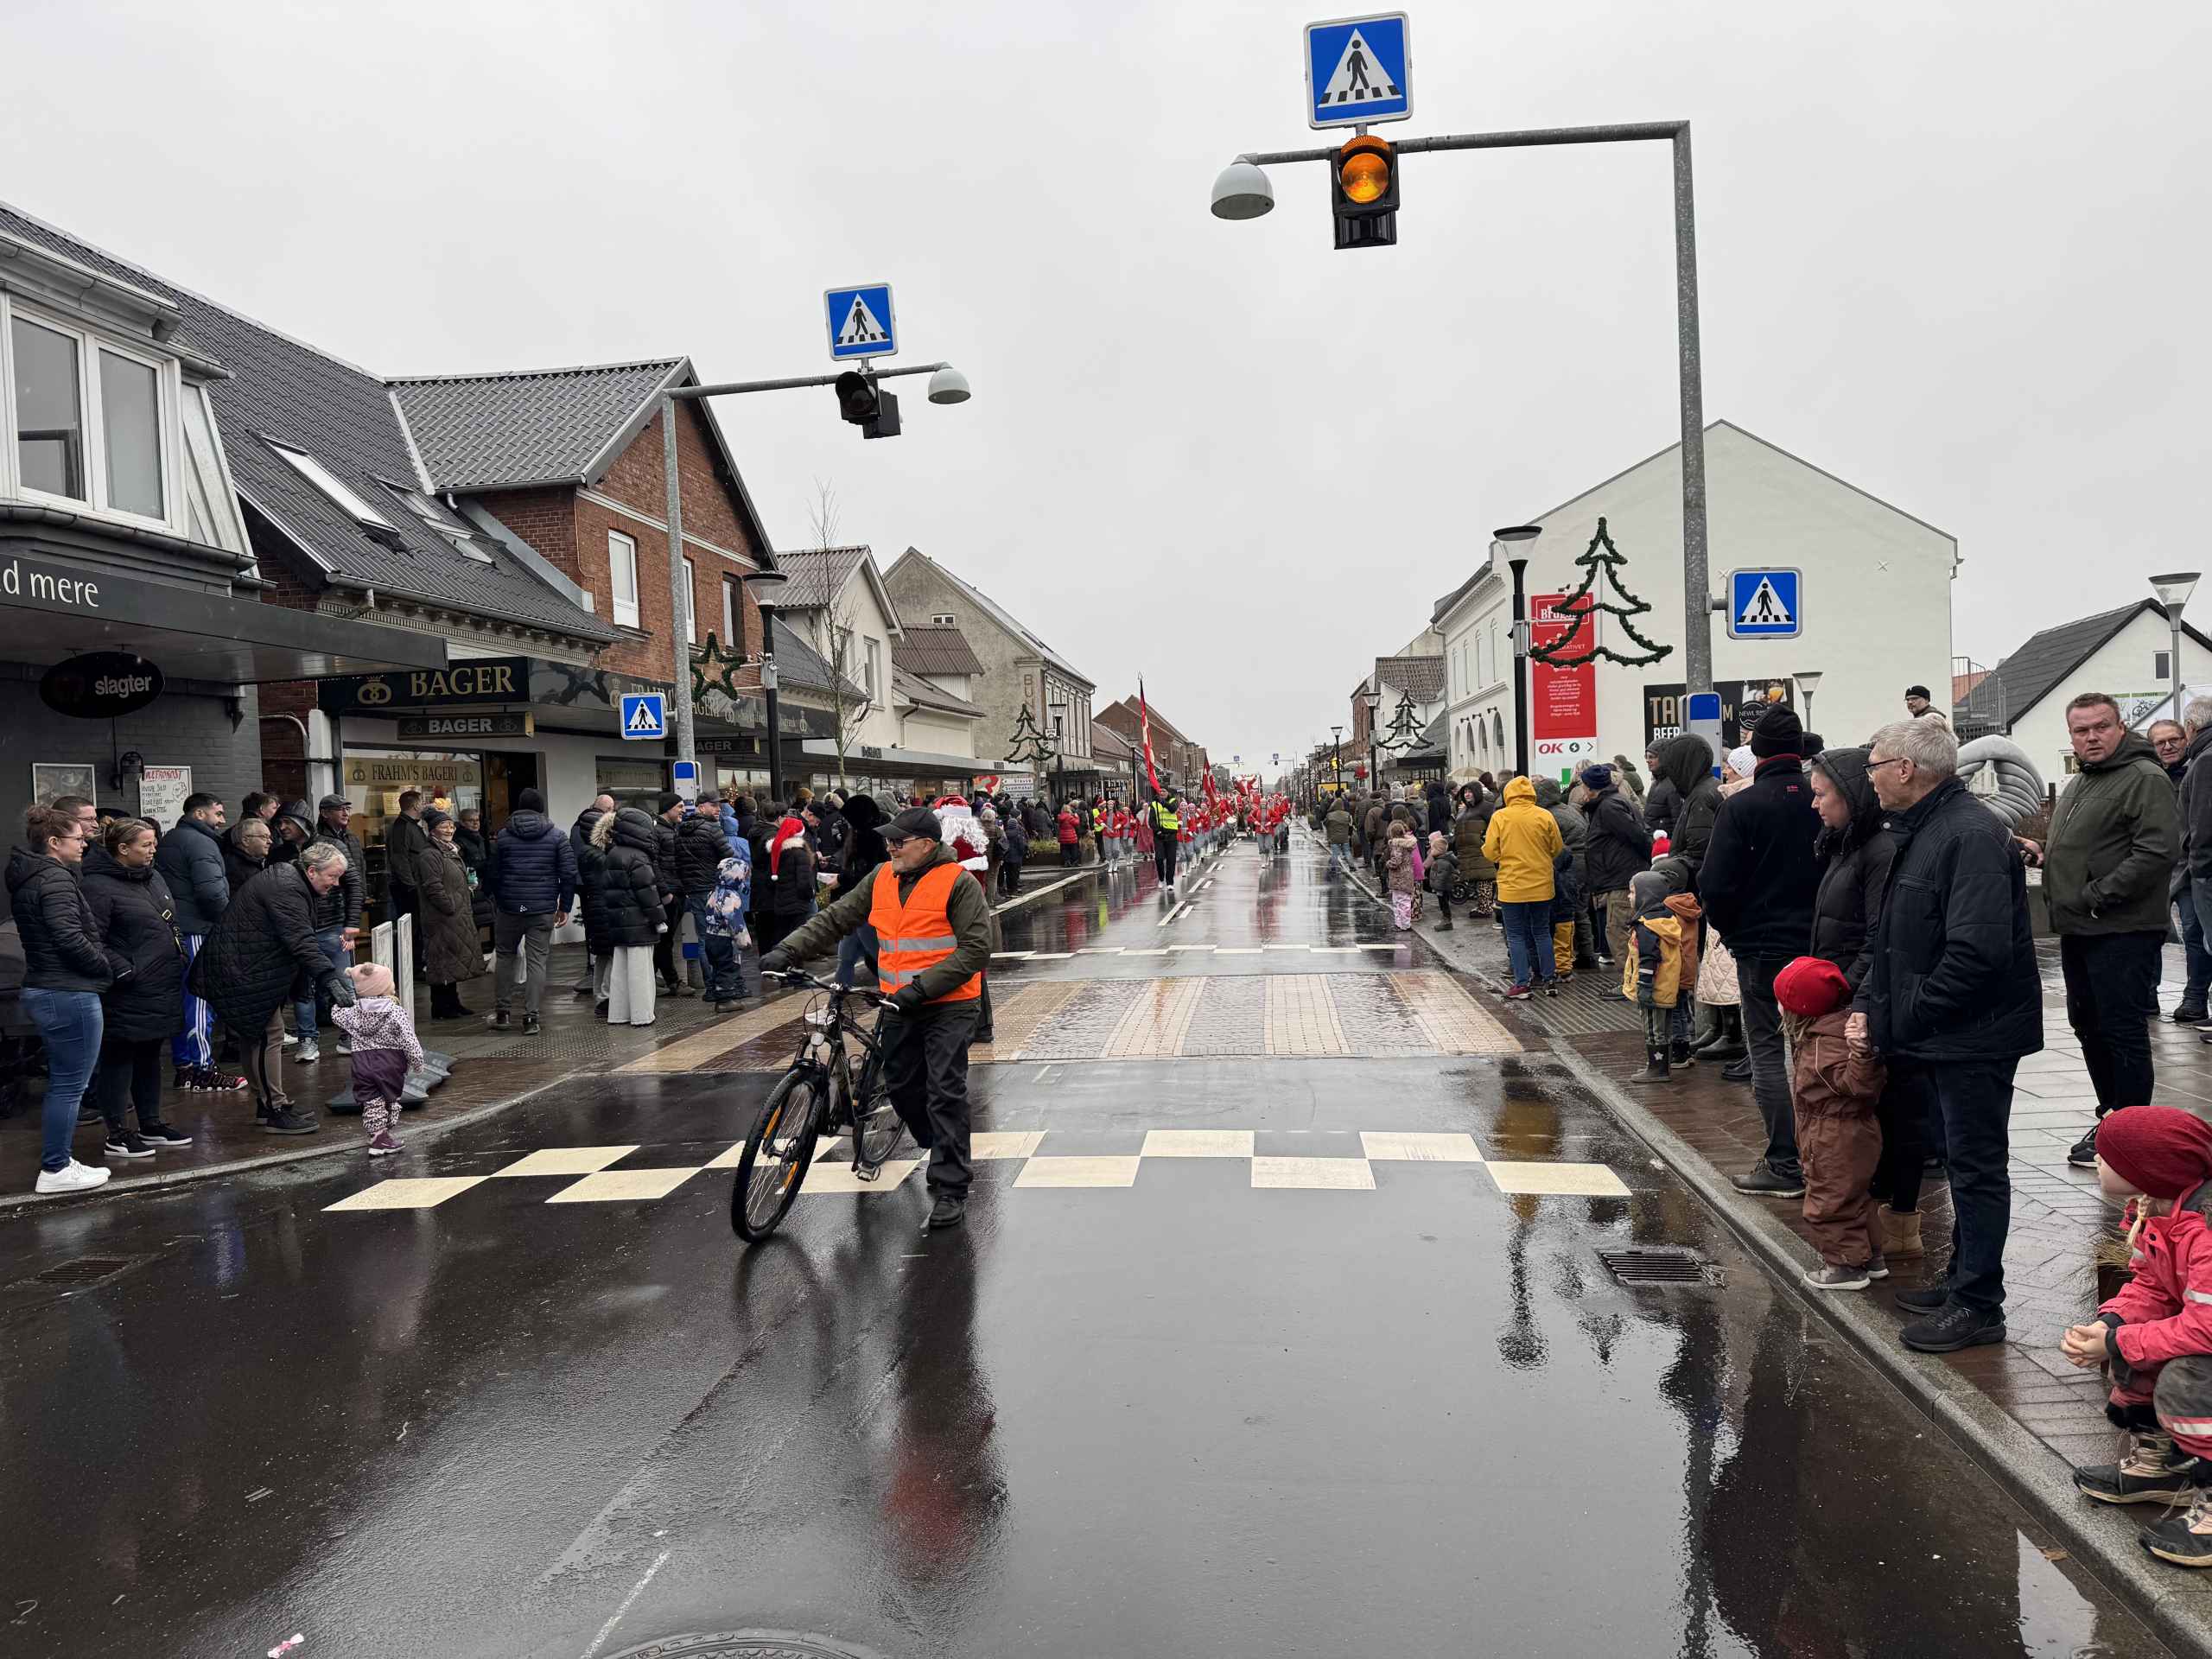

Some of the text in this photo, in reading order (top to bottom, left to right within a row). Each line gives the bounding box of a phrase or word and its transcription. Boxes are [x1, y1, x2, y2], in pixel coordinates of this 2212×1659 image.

[0, 560, 99, 607] d mere
[95, 674, 152, 698] slagter
[410, 665, 516, 698] BAGER
[691, 694, 720, 718] AGERI
[1649, 695, 1681, 725] TA
[429, 718, 493, 734] BAGER
[696, 740, 732, 752] AGER
[1539, 743, 1563, 753] OK
[372, 764, 457, 781] FRAHM'S BAGERI
